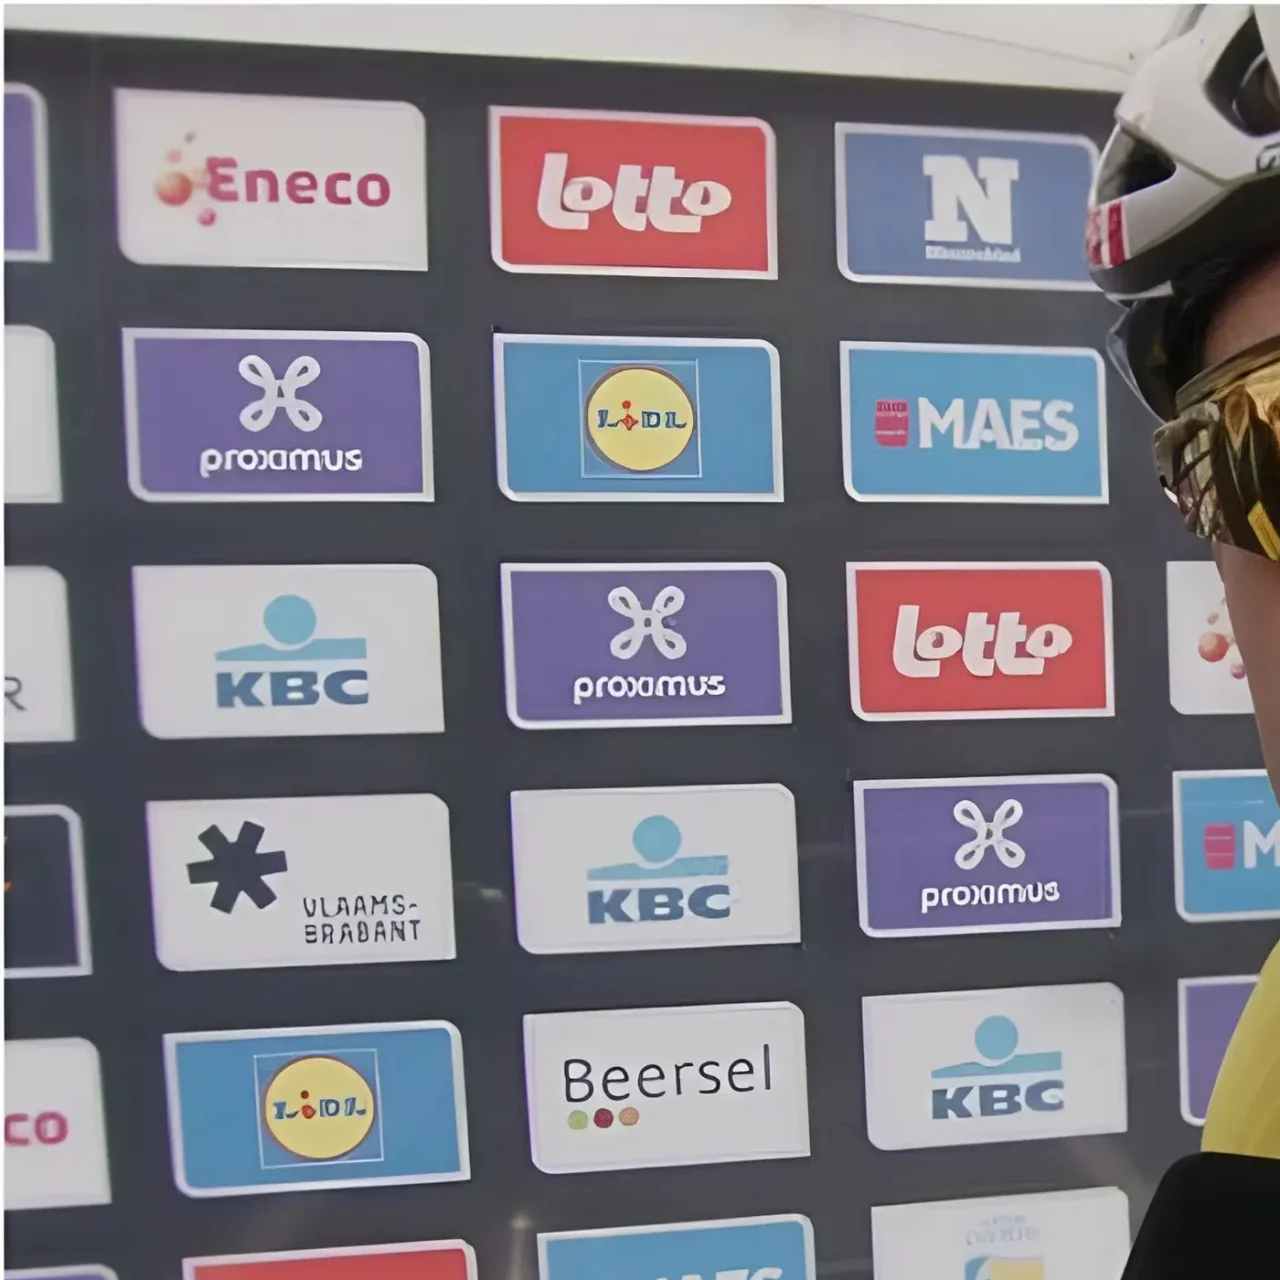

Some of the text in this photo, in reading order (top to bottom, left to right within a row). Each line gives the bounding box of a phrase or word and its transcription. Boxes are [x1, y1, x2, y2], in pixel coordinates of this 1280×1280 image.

[206, 157, 391, 208] Eneco
[918, 397, 1080, 451] MAES
[215, 669, 370, 708] KBC
[587, 884, 731, 925] KBC
[563, 1043, 773, 1103] Beersel
[931, 1079, 1066, 1120] KBC
